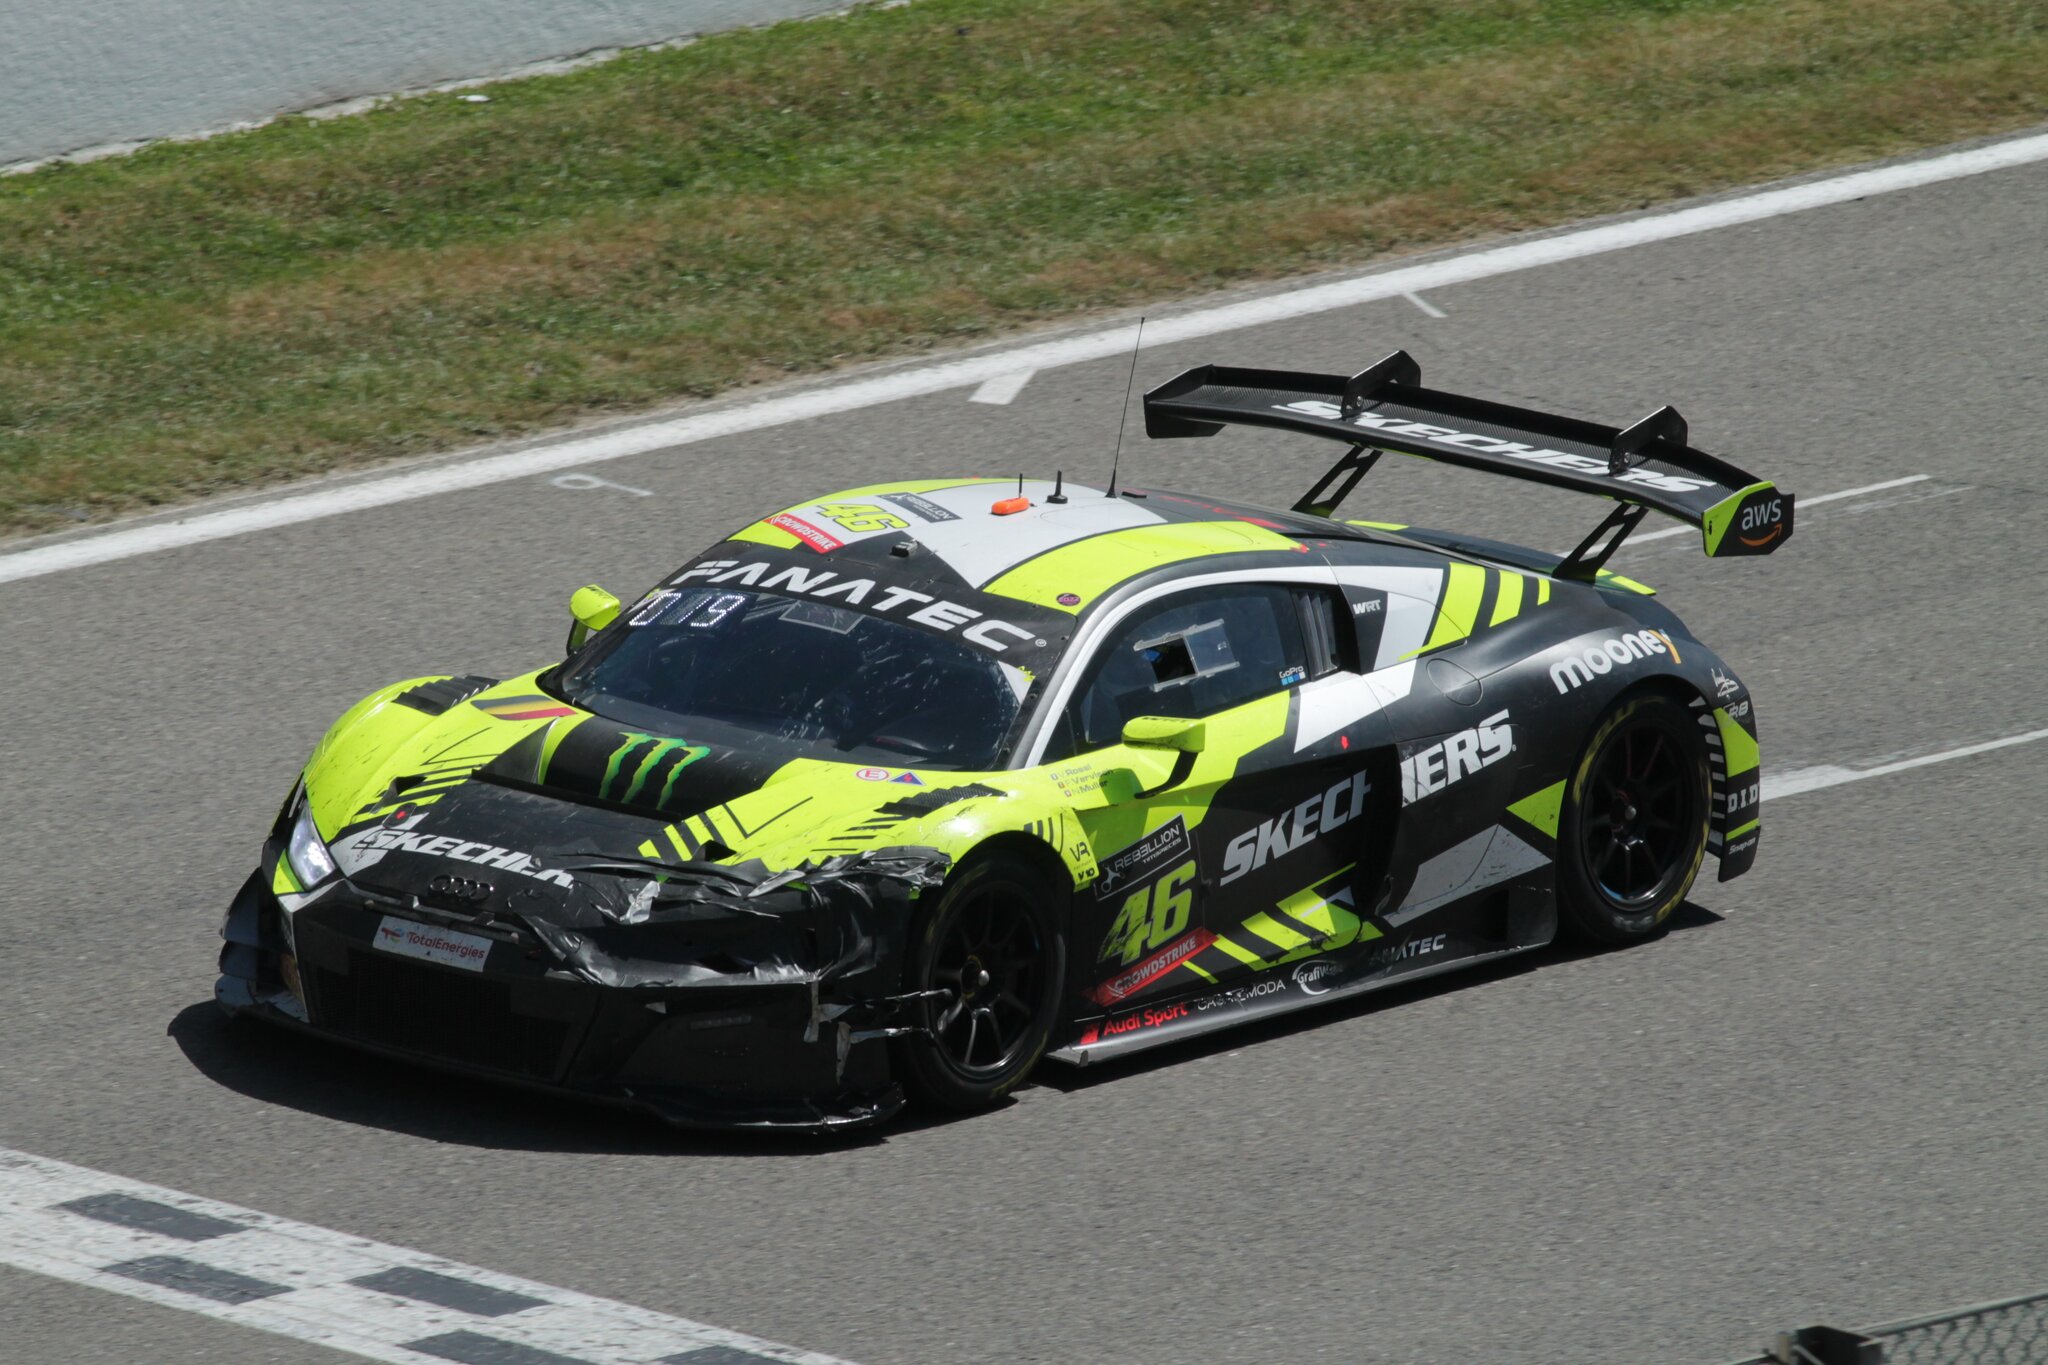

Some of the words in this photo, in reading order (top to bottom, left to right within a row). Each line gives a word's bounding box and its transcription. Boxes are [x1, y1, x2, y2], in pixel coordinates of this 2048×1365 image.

[817, 503, 911, 532] 46
[1741, 499, 1782, 531] aws
[779, 516, 838, 550] CROWDSTRIKE
[668, 560, 1037, 652] FANATEC
[1353, 600, 1381, 614] WRT
[1279, 666, 1304, 679] GoPro
[1550, 628, 1682, 695] mooney
[1115, 824, 1180, 872] REBELLION
[1097, 859, 1196, 966] 46
[407, 931, 486, 958] TotalEnergies
[1114, 935, 1197, 992] CROWDSTRIKE
[1104, 1013, 1141, 1036] Audi
[1145, 1002, 1188, 1027] Sport
